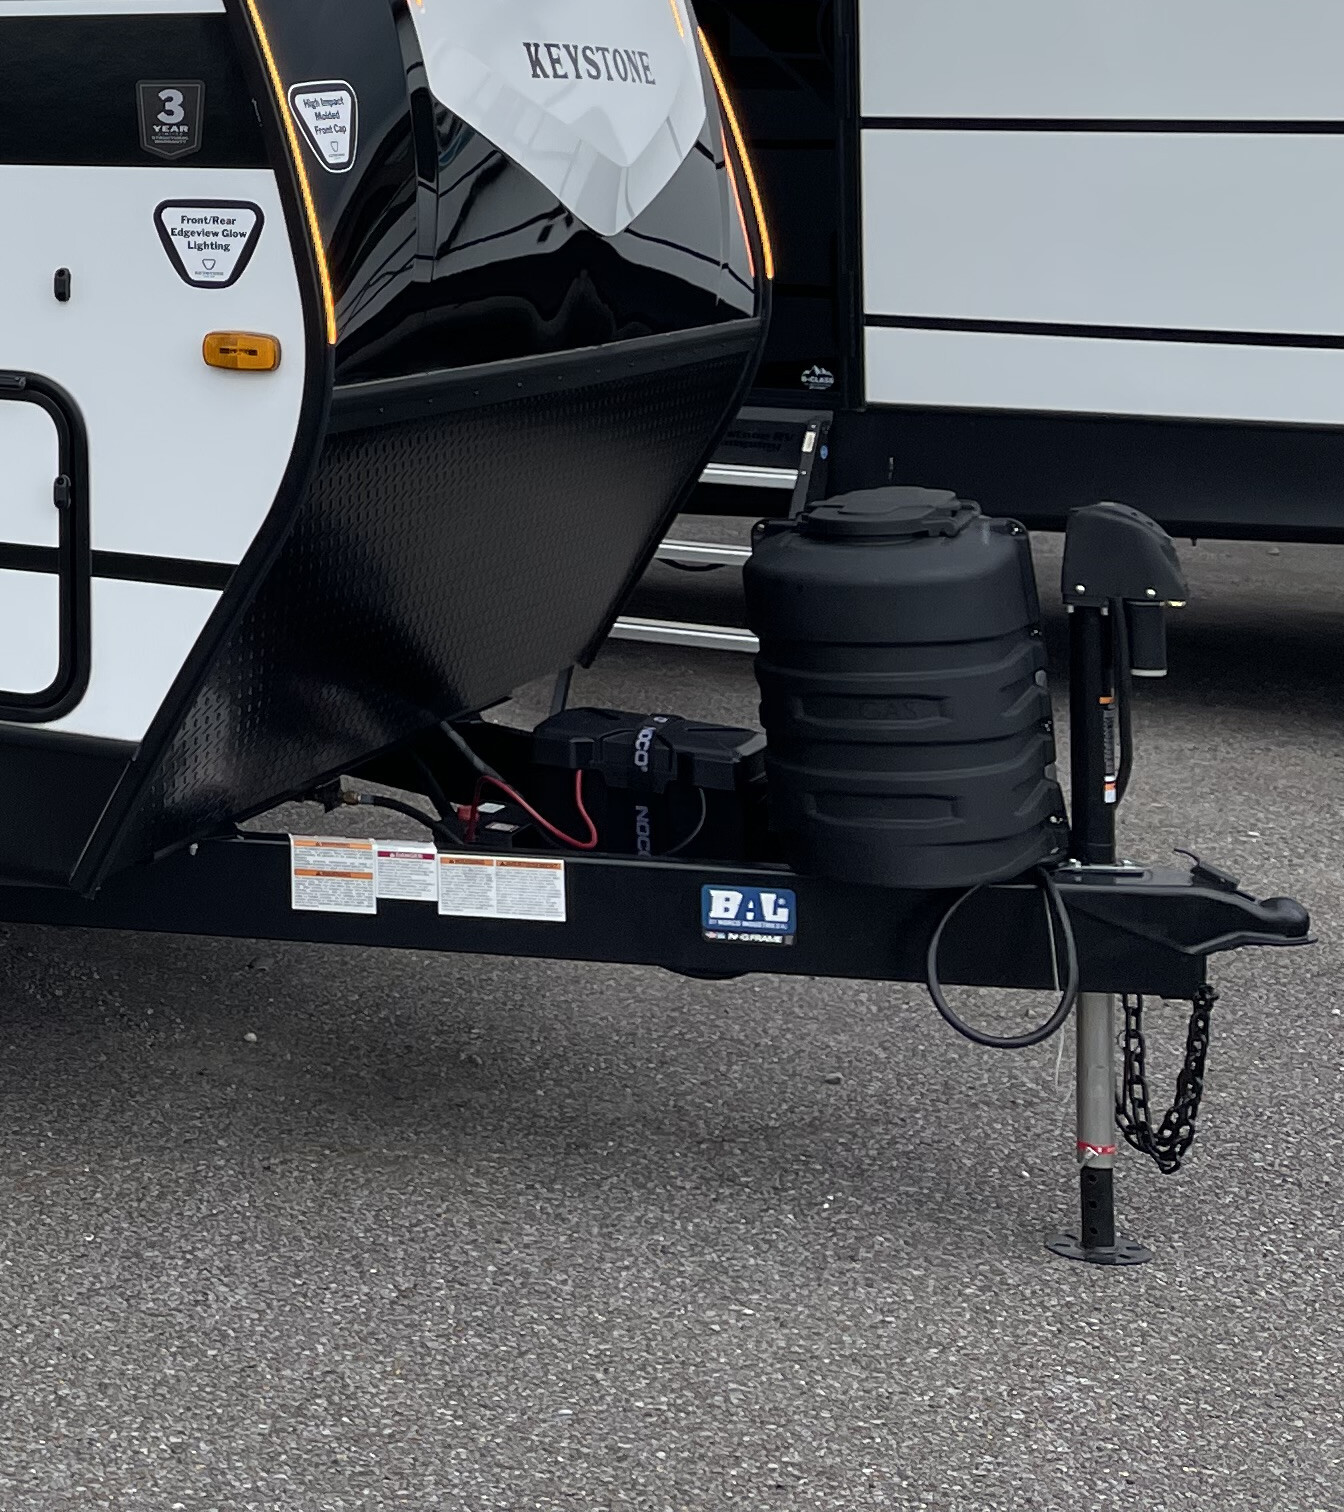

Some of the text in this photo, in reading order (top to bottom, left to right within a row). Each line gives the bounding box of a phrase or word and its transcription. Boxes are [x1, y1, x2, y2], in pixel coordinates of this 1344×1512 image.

[523, 42, 656, 85] KEYSTONE
[157, 89, 185, 124] 3
[303, 96, 345, 110] High Impact
[152, 125, 189, 133] YEAR
[314, 123, 347, 136] Front Cap
[180, 215, 237, 226] Front/Rear
[170, 228, 248, 239] Edgeview Glow
[187, 241, 231, 252] Lighting
[708, 889, 790, 922] BAL
